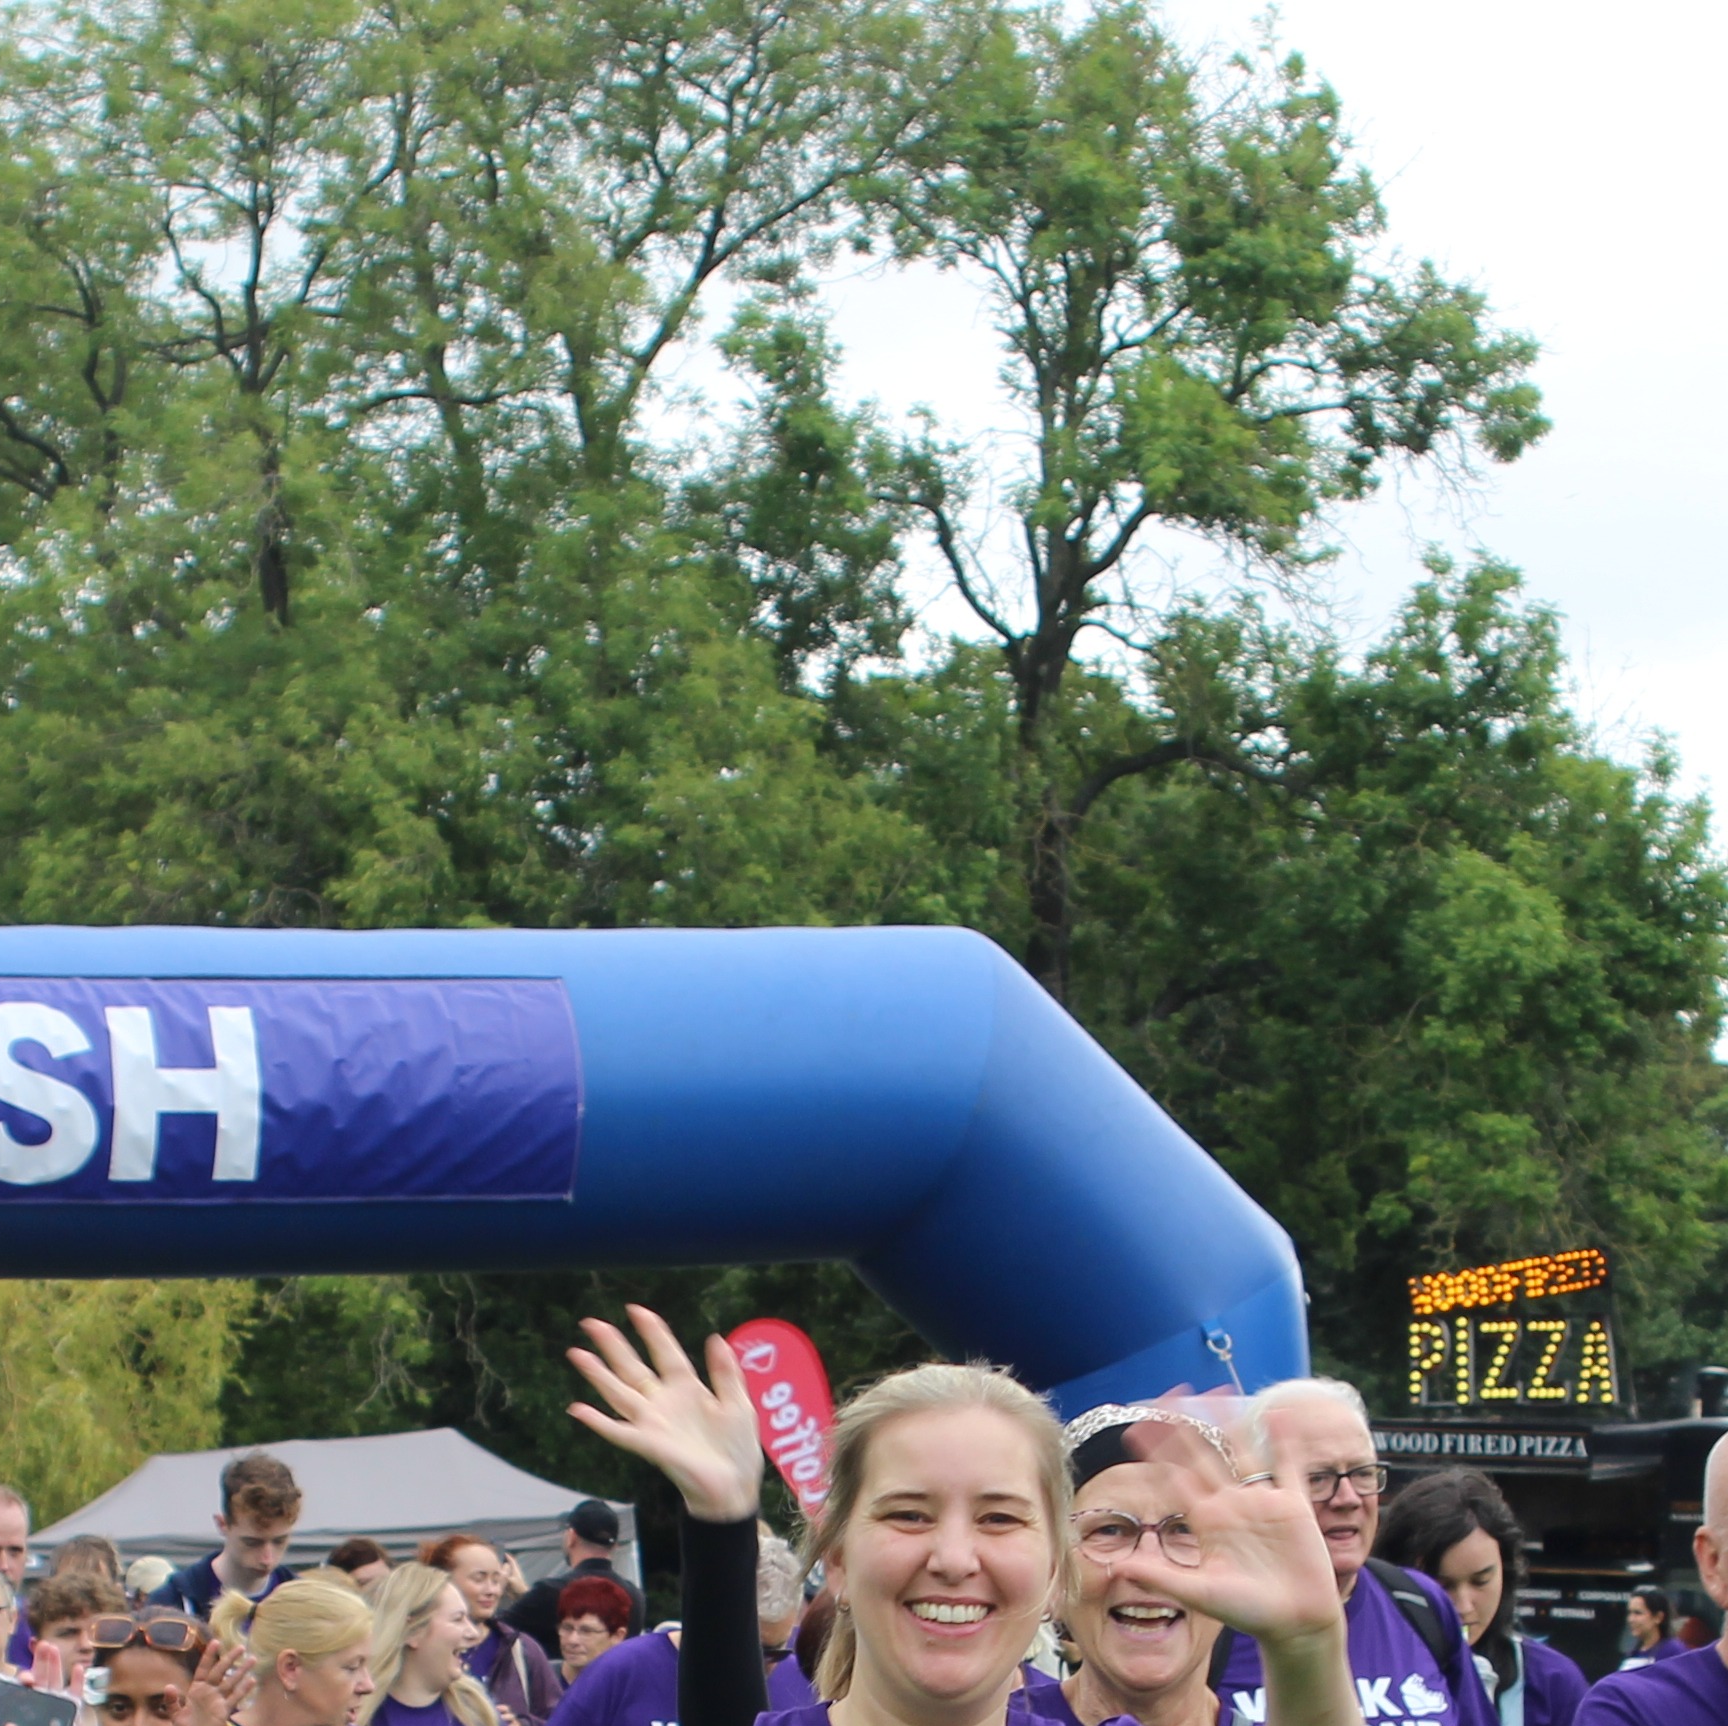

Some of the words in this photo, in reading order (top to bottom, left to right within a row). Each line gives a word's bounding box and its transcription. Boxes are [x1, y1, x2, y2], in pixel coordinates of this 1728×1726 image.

[1409, 1316, 1614, 1404] PIZZA
[1373, 1431, 1439, 1453] WOOD
[1442, 1433, 1517, 1456] FIRED
[1519, 1435, 1588, 1457] PIZZA
